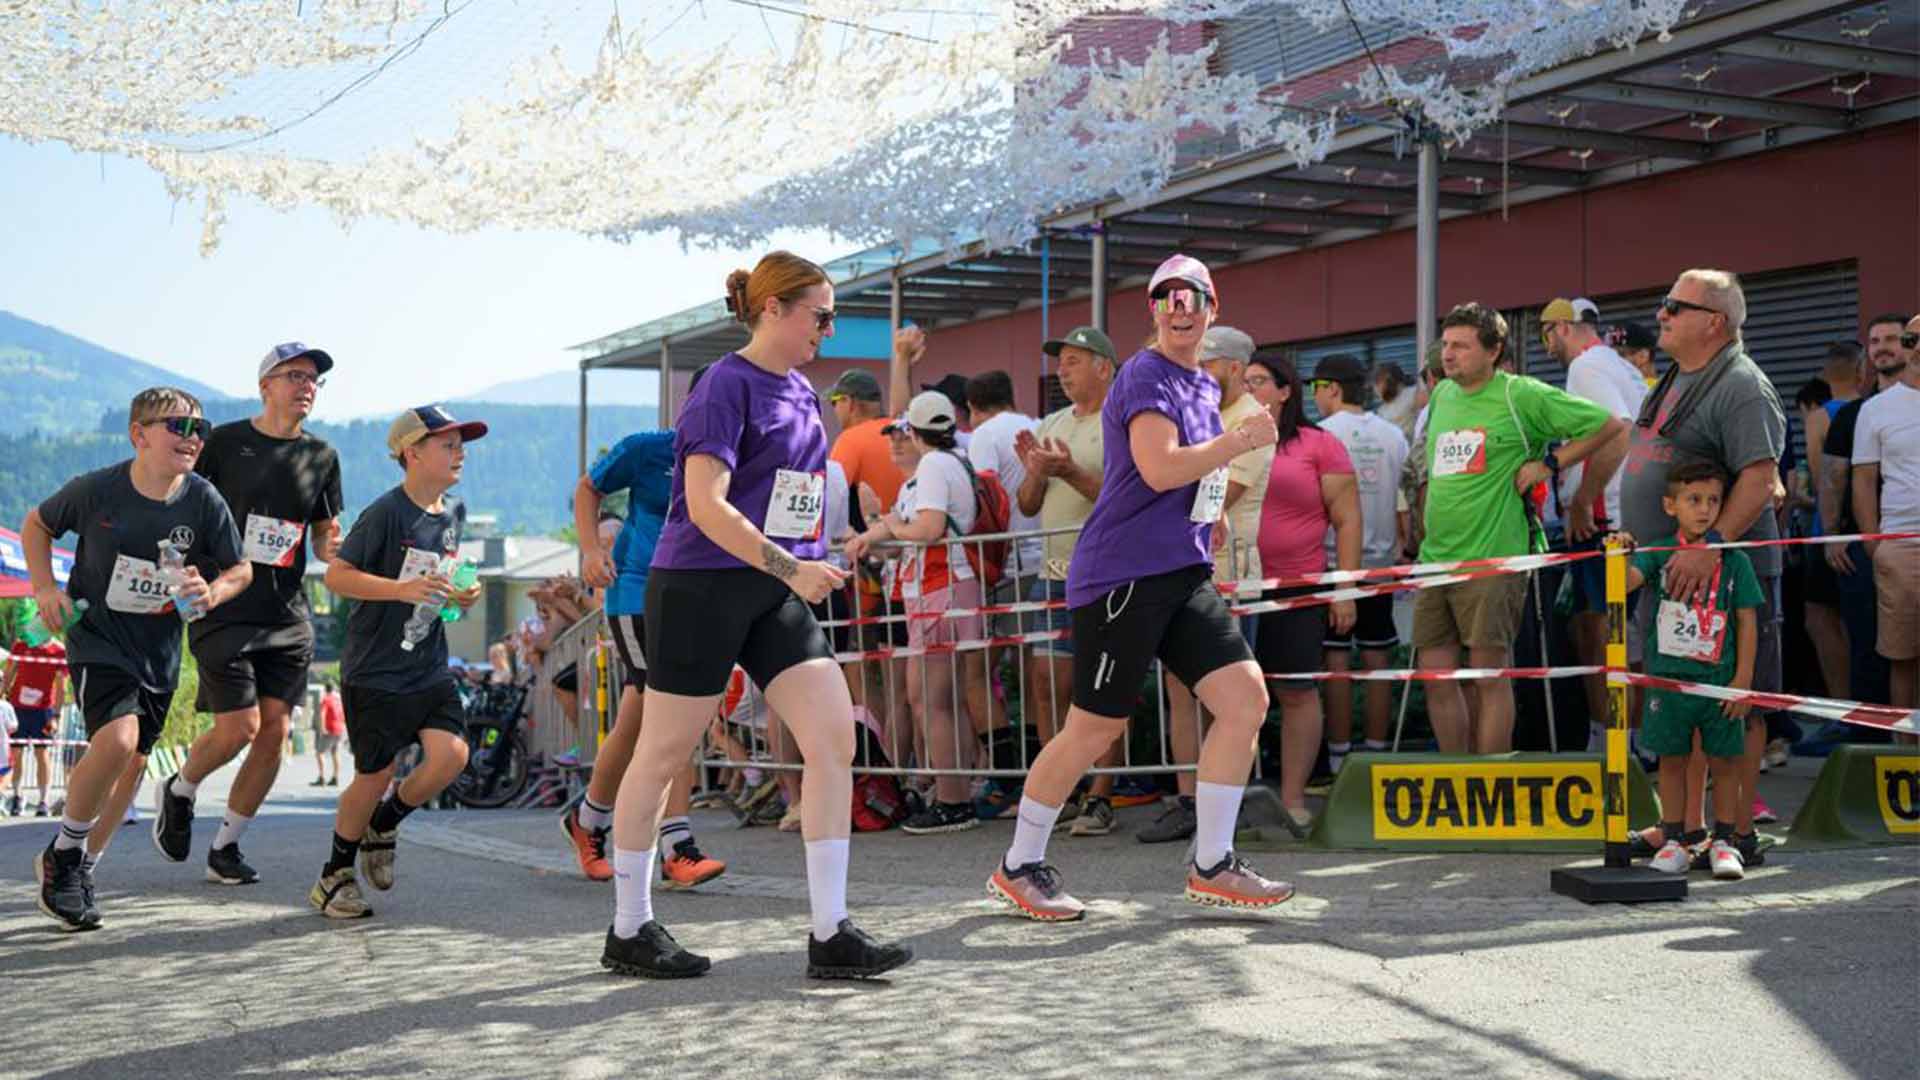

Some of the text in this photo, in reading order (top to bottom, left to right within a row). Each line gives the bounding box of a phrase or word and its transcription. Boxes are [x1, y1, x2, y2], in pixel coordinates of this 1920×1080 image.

[1442, 443, 1473, 458] 5016
[1673, 621, 1697, 638] 24
[1381, 775, 1595, 828] ÖAMTC
